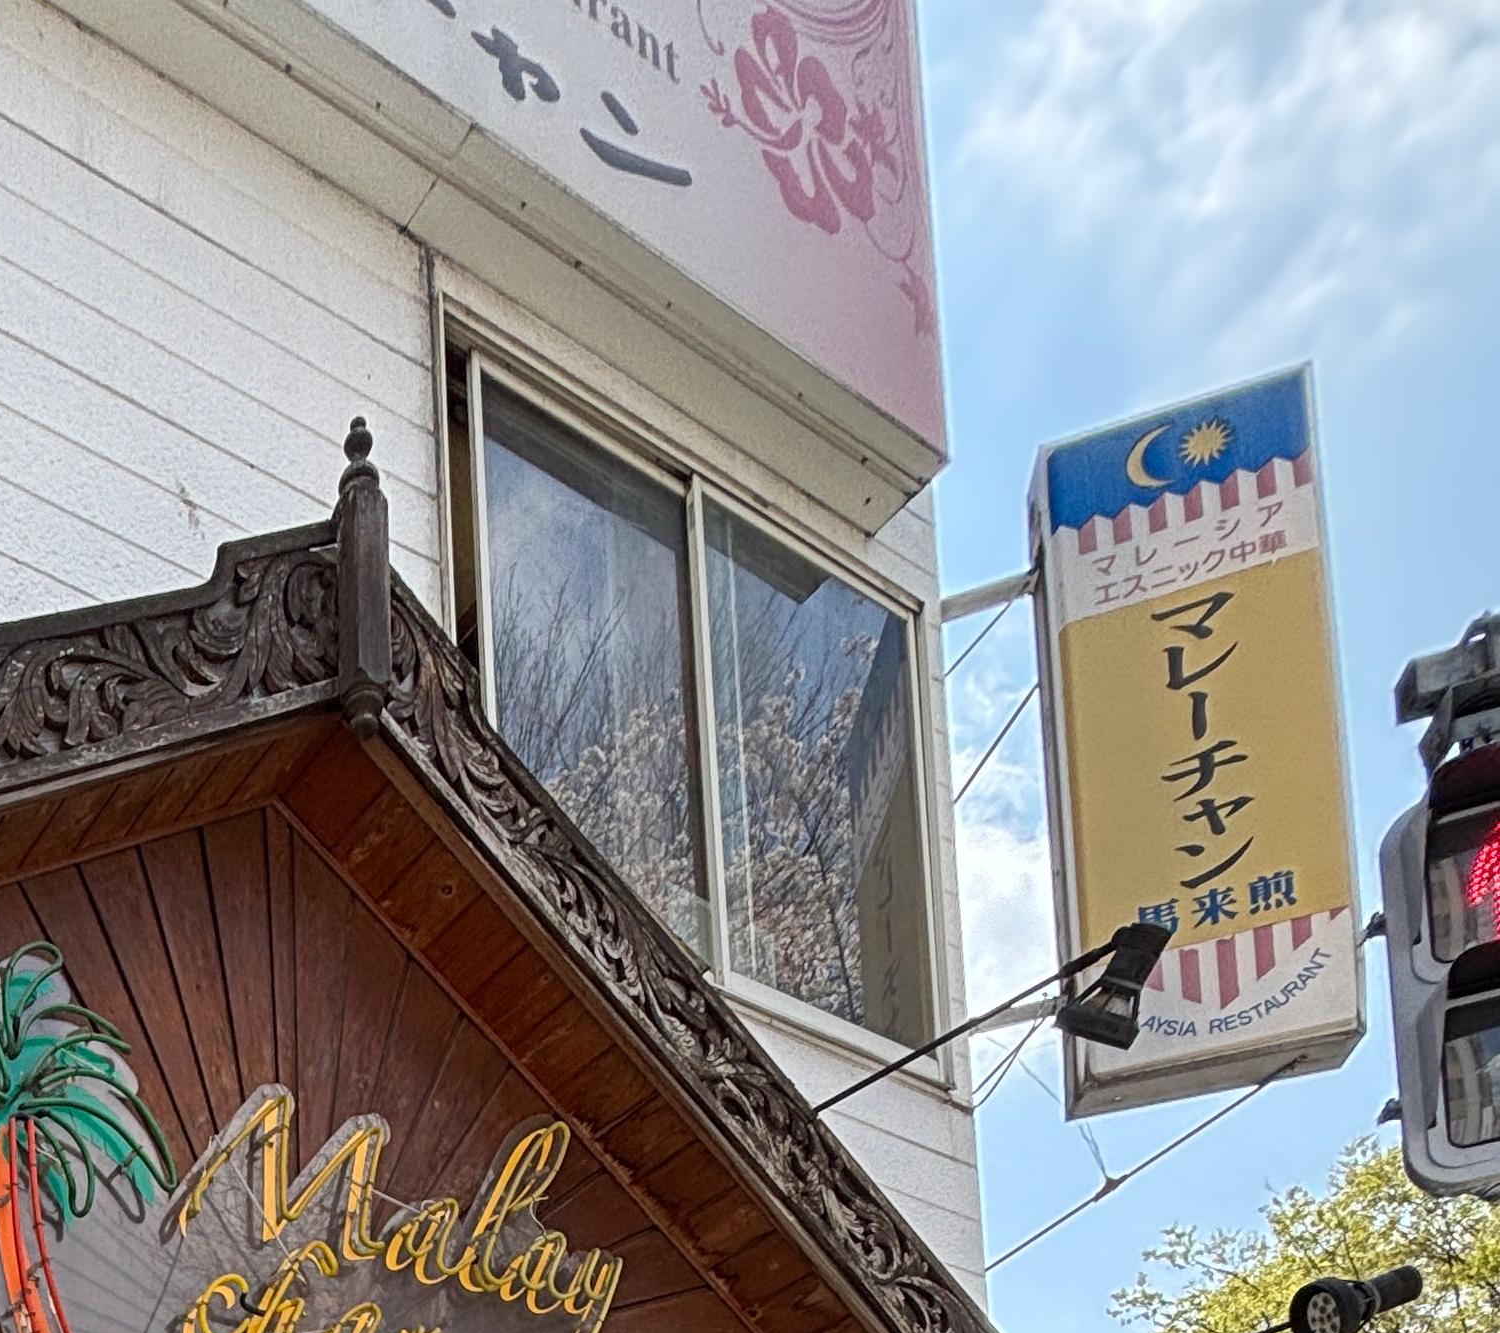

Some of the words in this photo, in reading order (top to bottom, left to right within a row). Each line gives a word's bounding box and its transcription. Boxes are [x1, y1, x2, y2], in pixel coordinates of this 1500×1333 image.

[1092, 501, 1284, 575] マレーシア
[1095, 529, 1288, 606] エスニック中華
[1150, 590, 1256, 890] マレーチャン
[1141, 1015, 1197, 1037] AYSIA
[1209, 948, 1332, 1034] RESTAURANT
